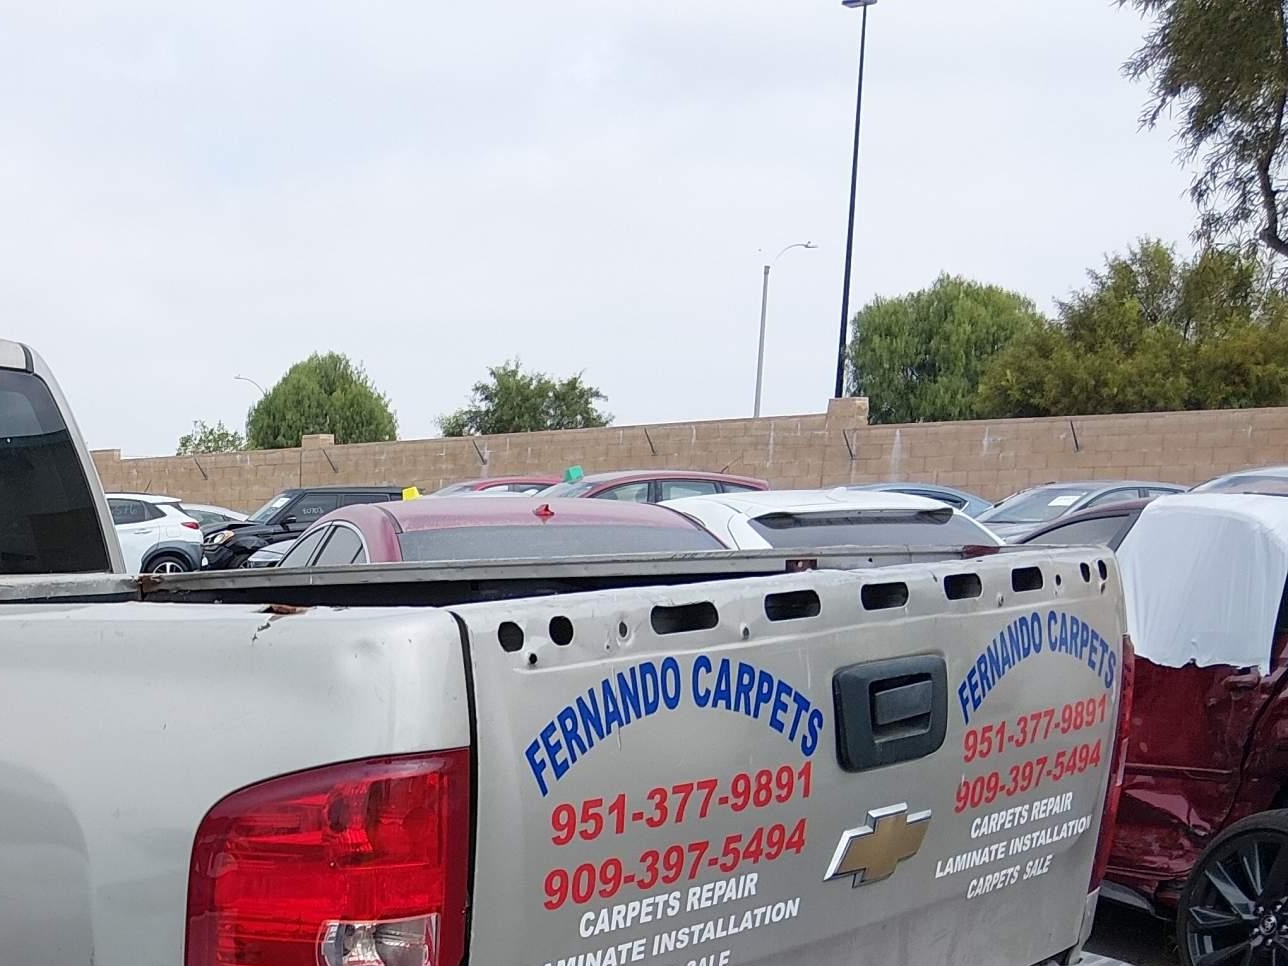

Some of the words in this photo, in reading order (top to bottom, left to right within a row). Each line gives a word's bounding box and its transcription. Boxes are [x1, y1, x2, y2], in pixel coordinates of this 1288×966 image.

[958, 611, 1043, 725] FERNANDO
[1047, 610, 1116, 689] CARPETS
[525, 656, 680, 797] FERNANDO
[692, 655, 824, 757] CARPETS
[963, 694, 1108, 763] 951-377-9891
[551, 760, 812, 846] 951-377-9891
[954, 739, 1102, 814] 909-397-5494
[970, 806, 1029, 839] CARPETS
[1032, 791, 1073, 822] REPAIR
[543, 818, 807, 911] 909-397-5494
[935, 841, 1007, 878] LAMINATE
[966, 864, 1019, 899] CARPETS
[1023, 854, 1053, 881] SALE
[579, 890, 680, 938] CARPETS
[686, 872, 758, 912] REPAIR
[652, 898, 800, 955] INSTALLATION
